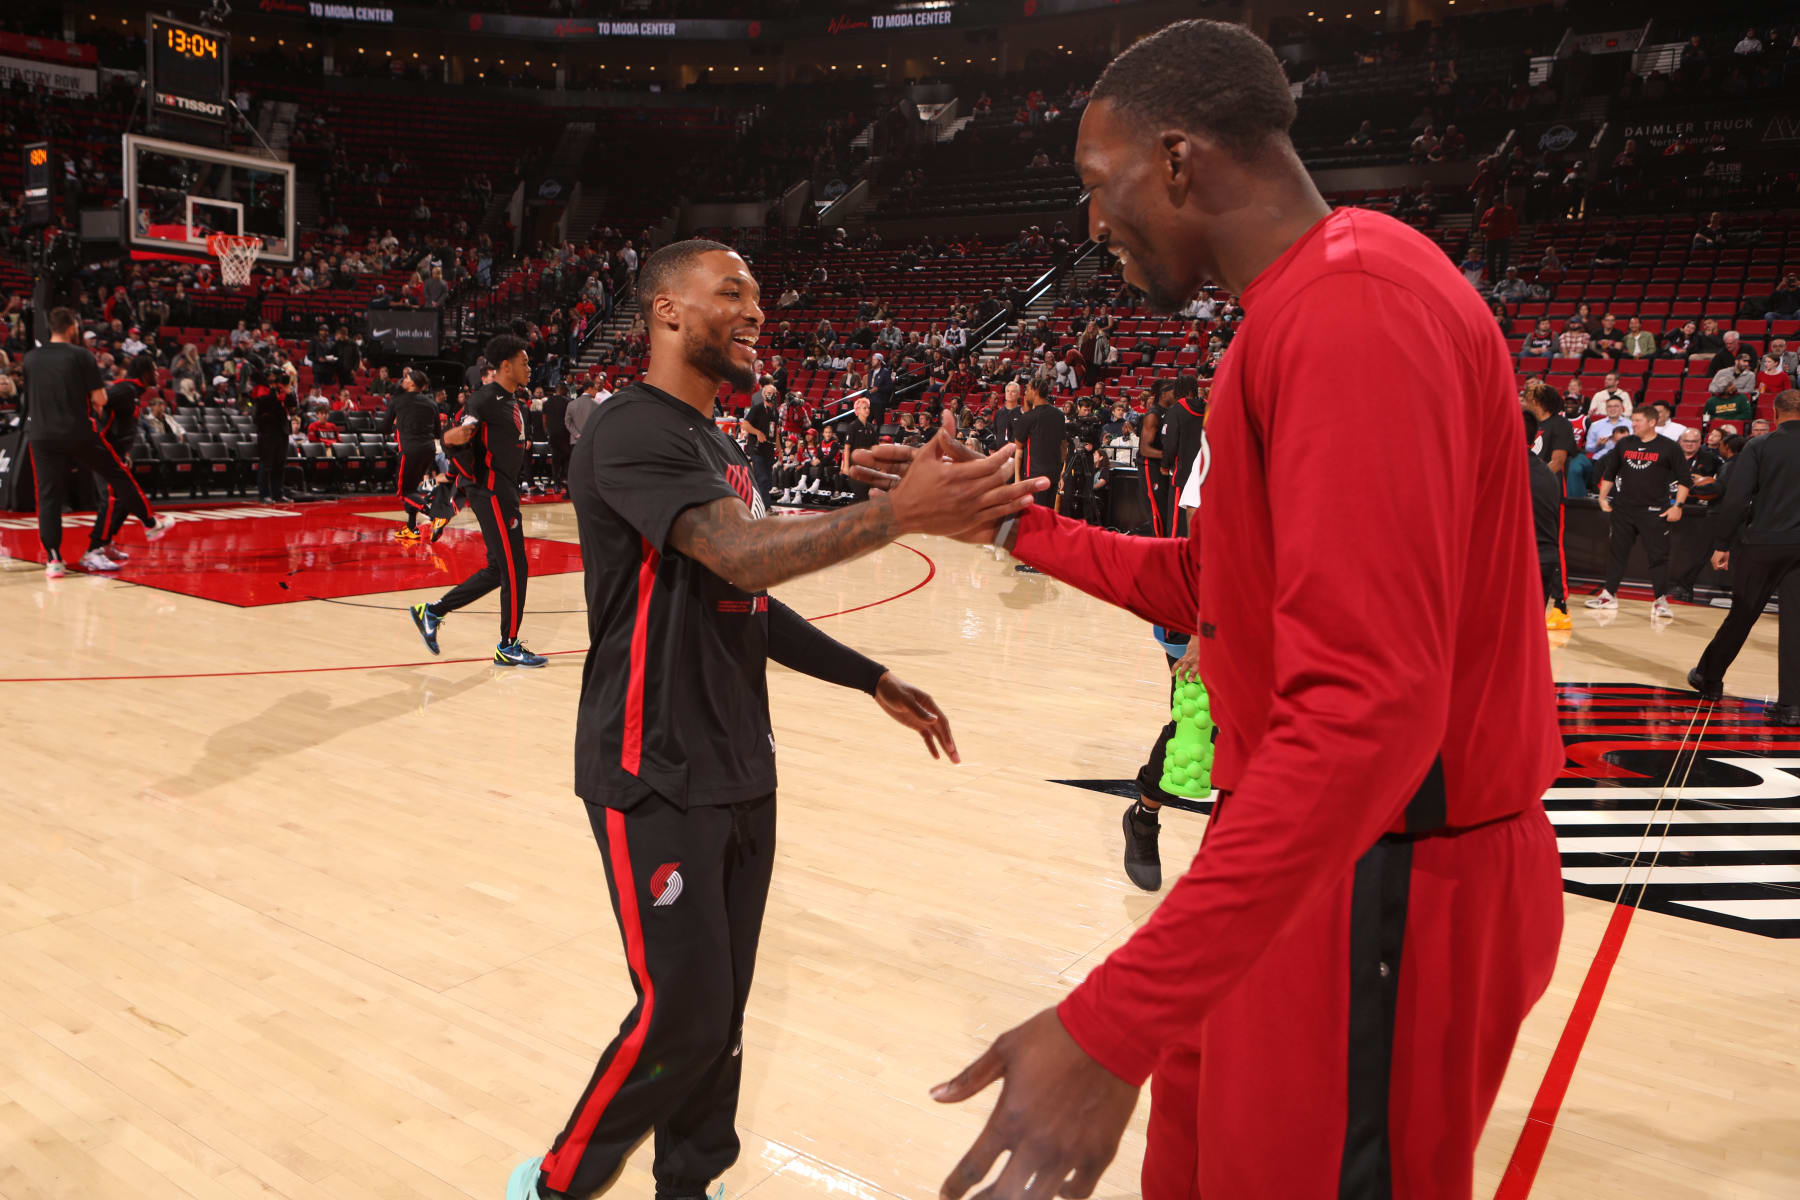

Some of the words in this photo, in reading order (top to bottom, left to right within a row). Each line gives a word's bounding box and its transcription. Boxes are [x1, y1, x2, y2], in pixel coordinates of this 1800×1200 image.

[309, 2, 323, 16] TO
[324, 4, 355, 19] MODA
[356, 7, 394, 22] CENTER
[872, 15, 884, 29] TO
[885, 13, 914, 28] MODA
[915, 11, 951, 26] CENTER
[598, 22, 610, 36] TO
[612, 22, 640, 36] MODA
[641, 22, 676, 36] CENTER
[168, 28, 218, 60] 13:04
[176, 96, 225, 116] TISSOT
[1624, 121, 1695, 137] DAIMLER
[1703, 116, 1755, 131] TRUCK
[395, 327, 411, 339] Just
[411, 328, 423, 338] do
[1623, 449, 1660, 462] PORTLAND
